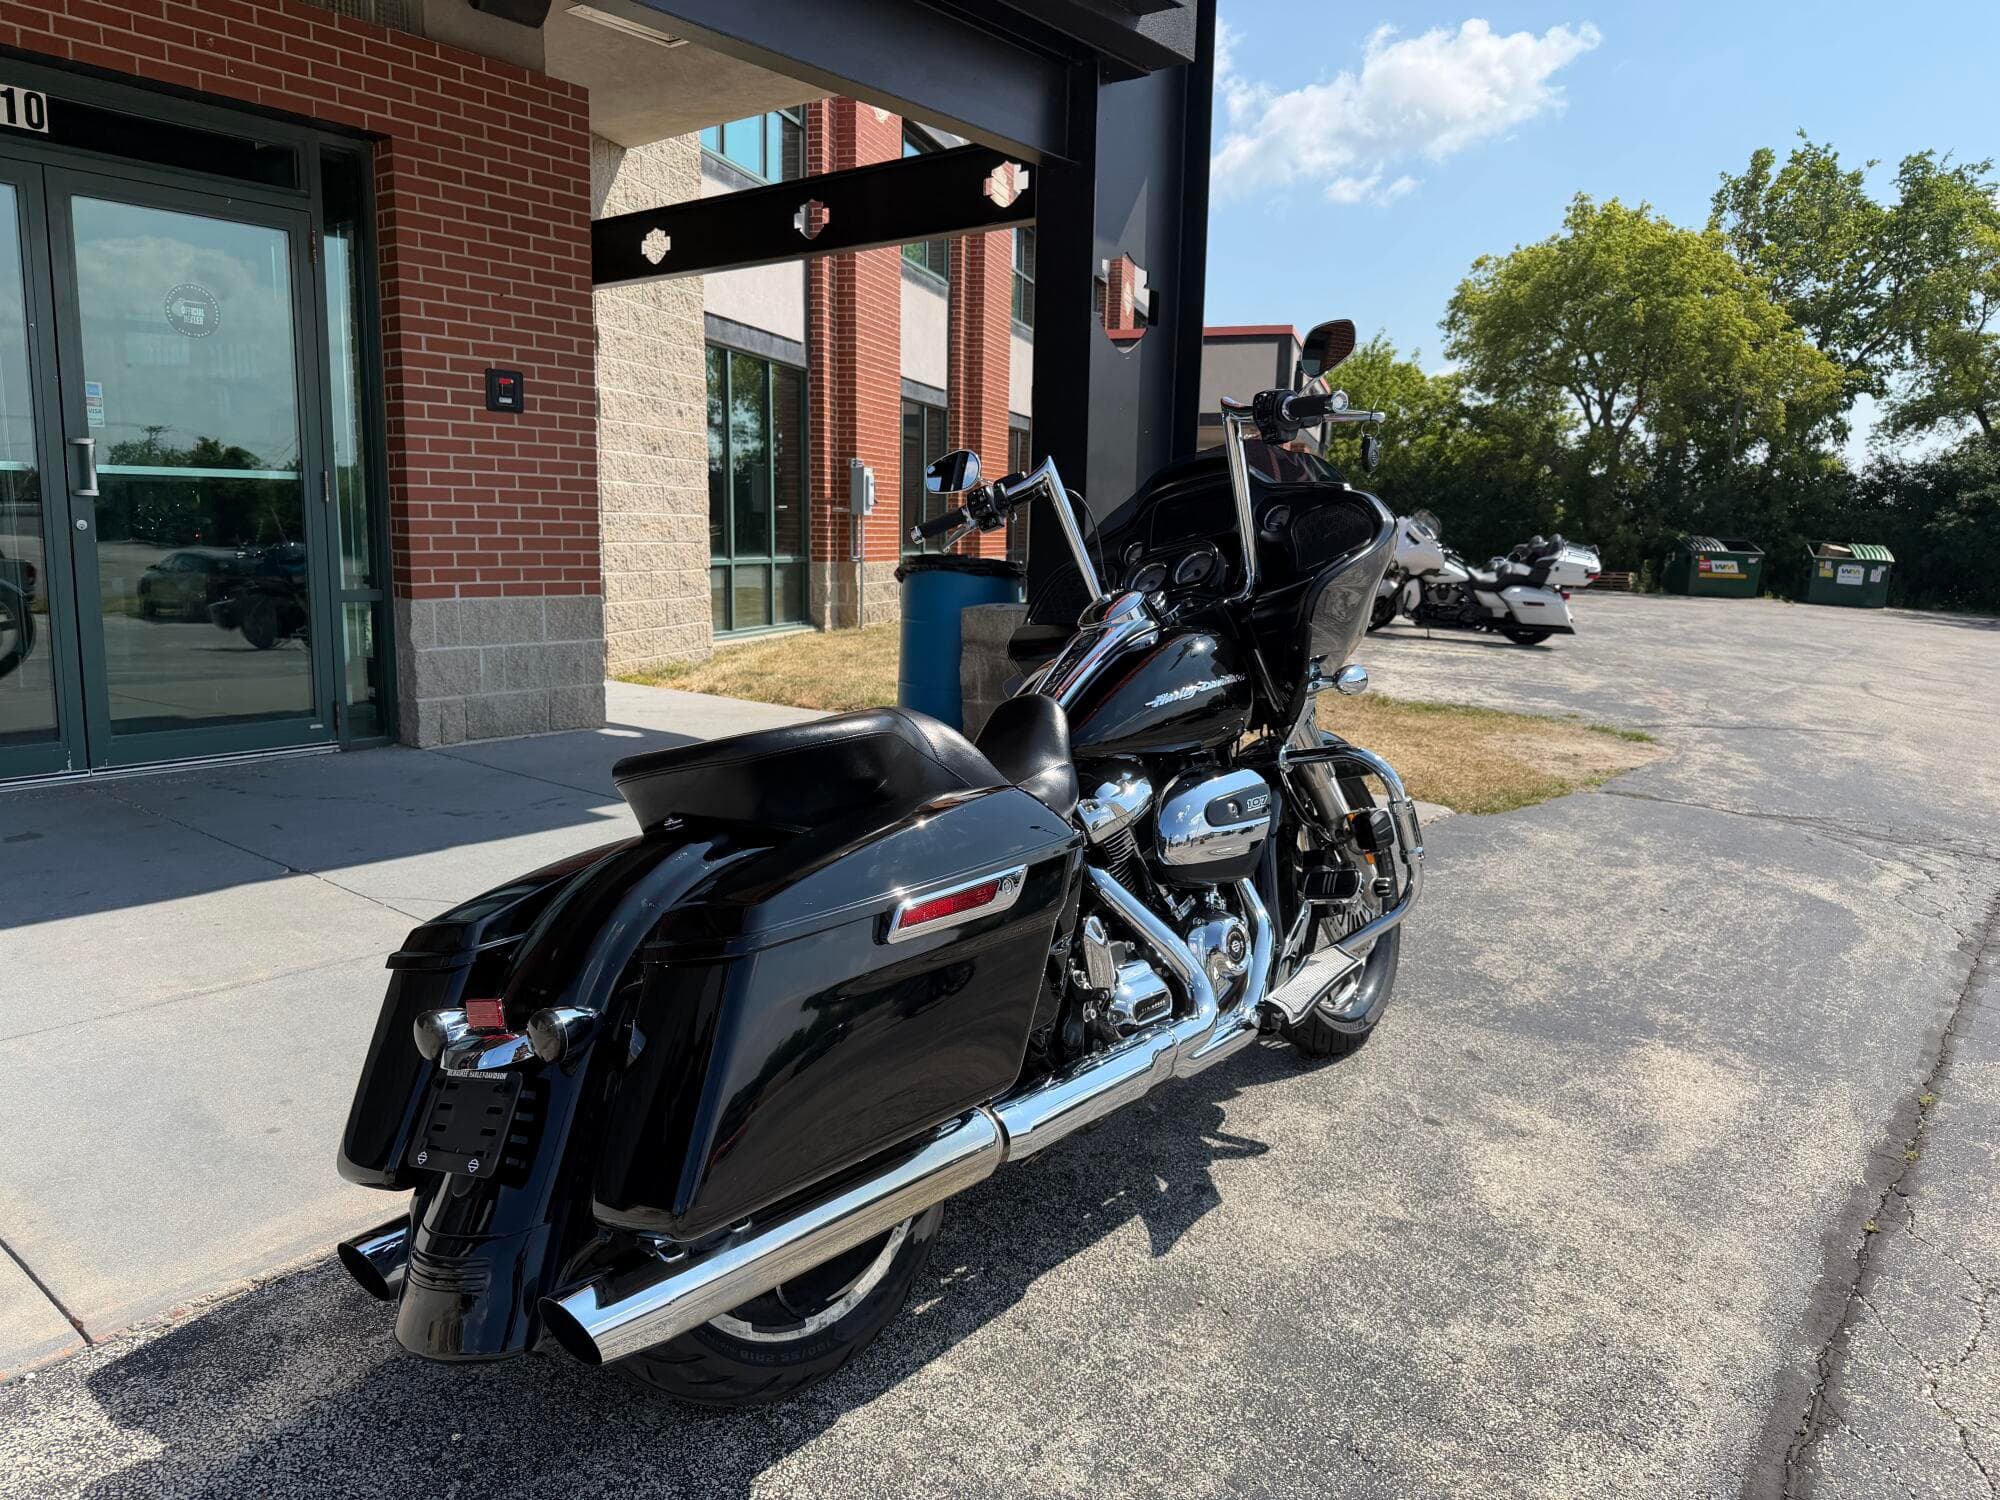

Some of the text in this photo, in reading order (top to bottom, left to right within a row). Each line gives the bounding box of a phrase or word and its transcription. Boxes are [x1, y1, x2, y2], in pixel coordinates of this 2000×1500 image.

[0, 87, 45, 130] 10
[1145, 673, 1246, 708] Harley-Davidson
[1247, 794, 1268, 809] 107
